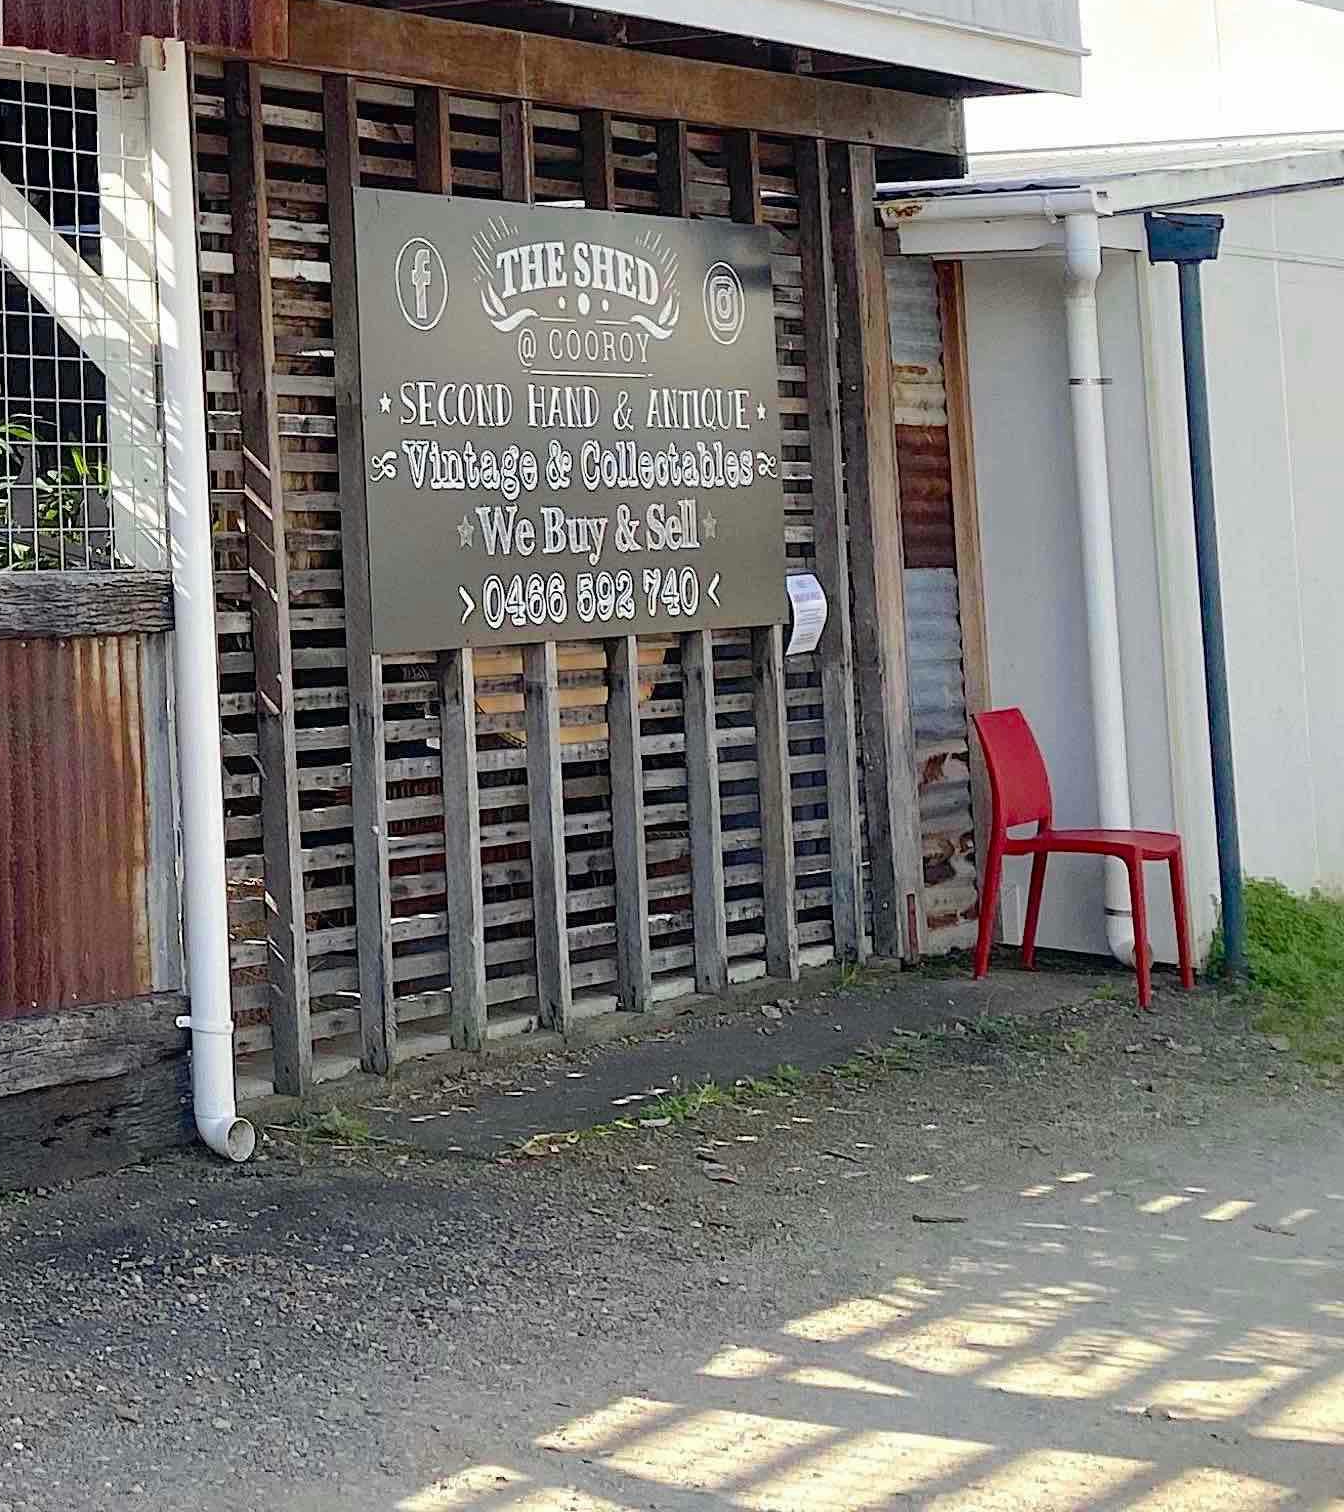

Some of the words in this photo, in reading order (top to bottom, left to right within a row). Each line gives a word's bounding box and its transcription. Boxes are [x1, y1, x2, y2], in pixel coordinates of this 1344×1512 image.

[496, 241, 567, 299] THE
[574, 242, 659, 307] SHED
[518, 329, 536, 368] @
[548, 328, 650, 364] COOROY
[399, 381, 512, 428] SECOND
[528, 385, 600, 429] HAND
[612, 389, 634, 431] &
[647, 386, 751, 430] ANTIQUE
[402, 439, 538, 500] Vintage
[545, 439, 573, 491] &
[580, 439, 753, 491] Collectables
[475, 503, 536, 556] We
[542, 506, 607, 564] Buy
[614, 503, 641, 553] &
[646, 499, 700, 551] Sell
[482, 571, 568, 629] 0466
[576, 568, 636, 623] 592
[642, 566, 700, 616] 740
